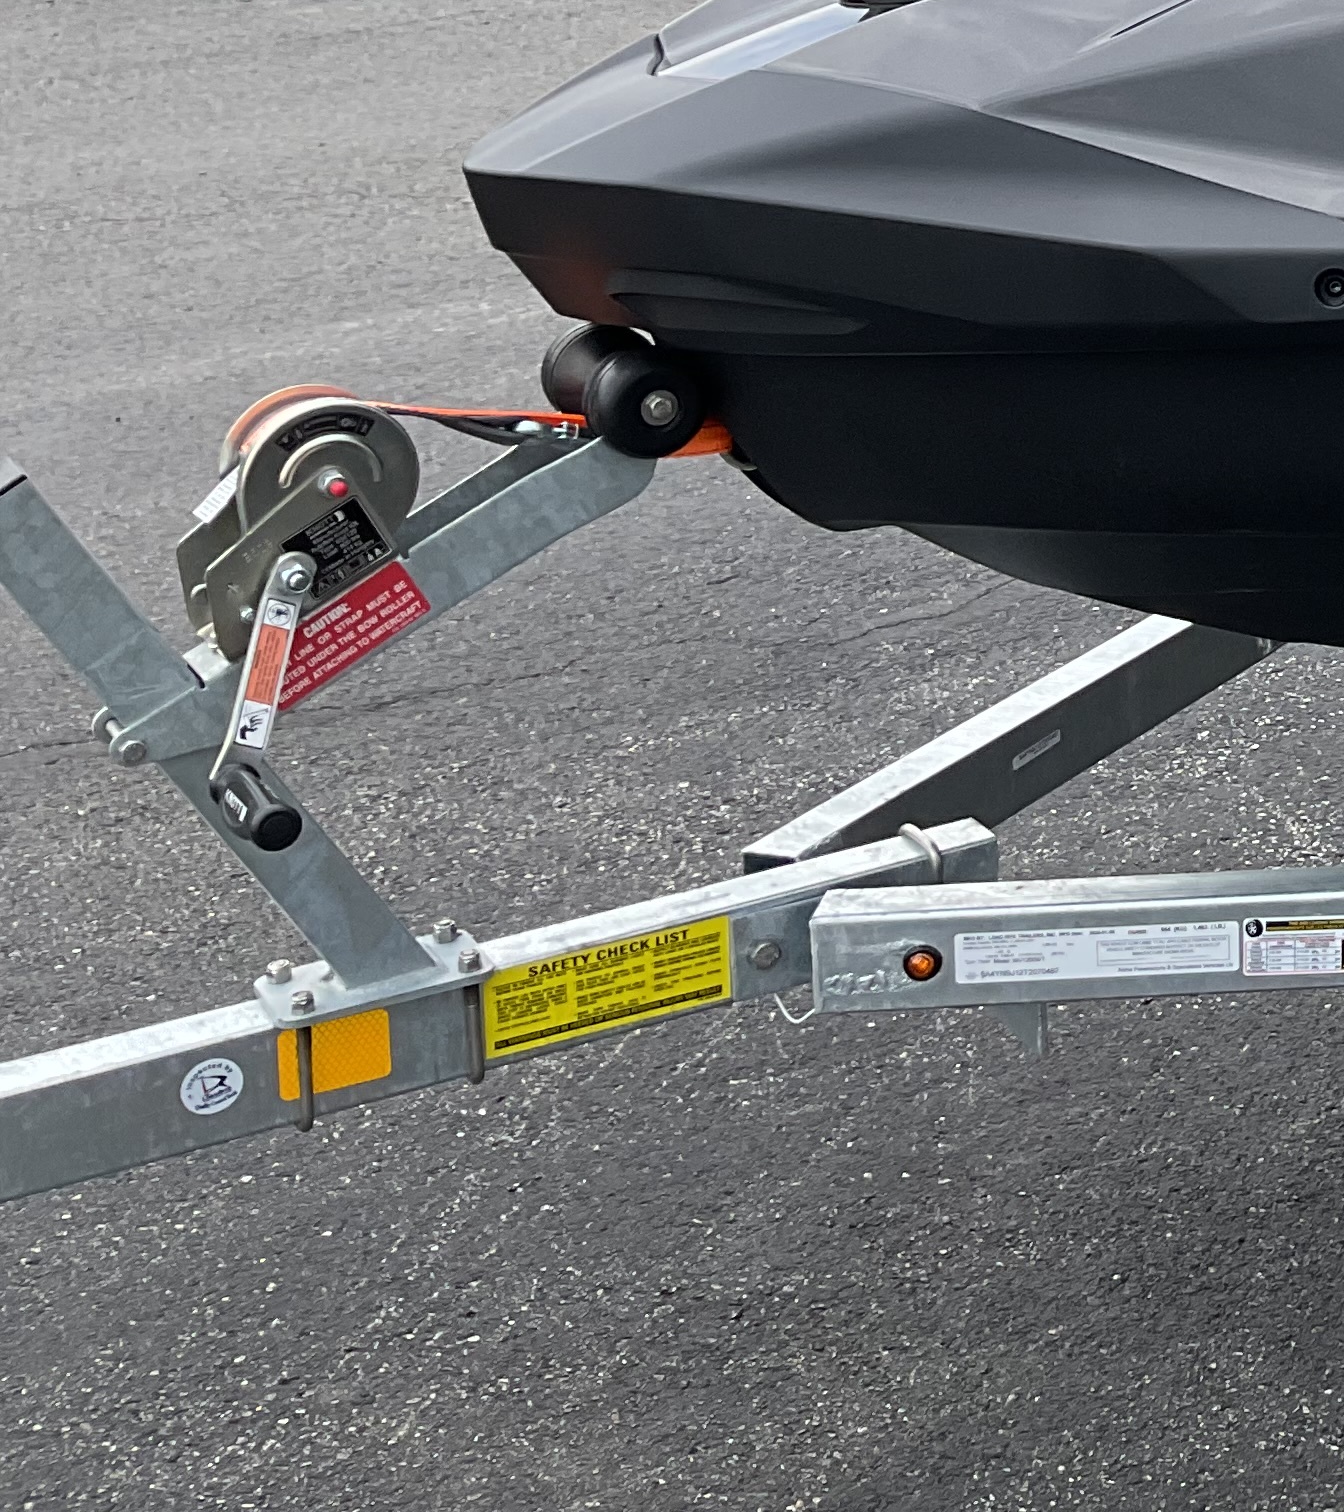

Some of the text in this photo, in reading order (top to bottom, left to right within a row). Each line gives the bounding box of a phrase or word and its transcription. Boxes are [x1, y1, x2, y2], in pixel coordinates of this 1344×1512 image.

[294, 580, 408, 661] LINE OR STRAP MUST BE
[306, 643, 339, 668] UNDER
[337, 630, 357, 646] THE
[356, 614, 379, 634] BOW
[379, 590, 416, 618] ROLLER
[312, 646, 358, 680] ATTACHING
[356, 636, 370, 648] TO
[369, 600, 422, 640] WATERCRAFT
[528, 928, 690, 978] SAFETY CHECK LIST
